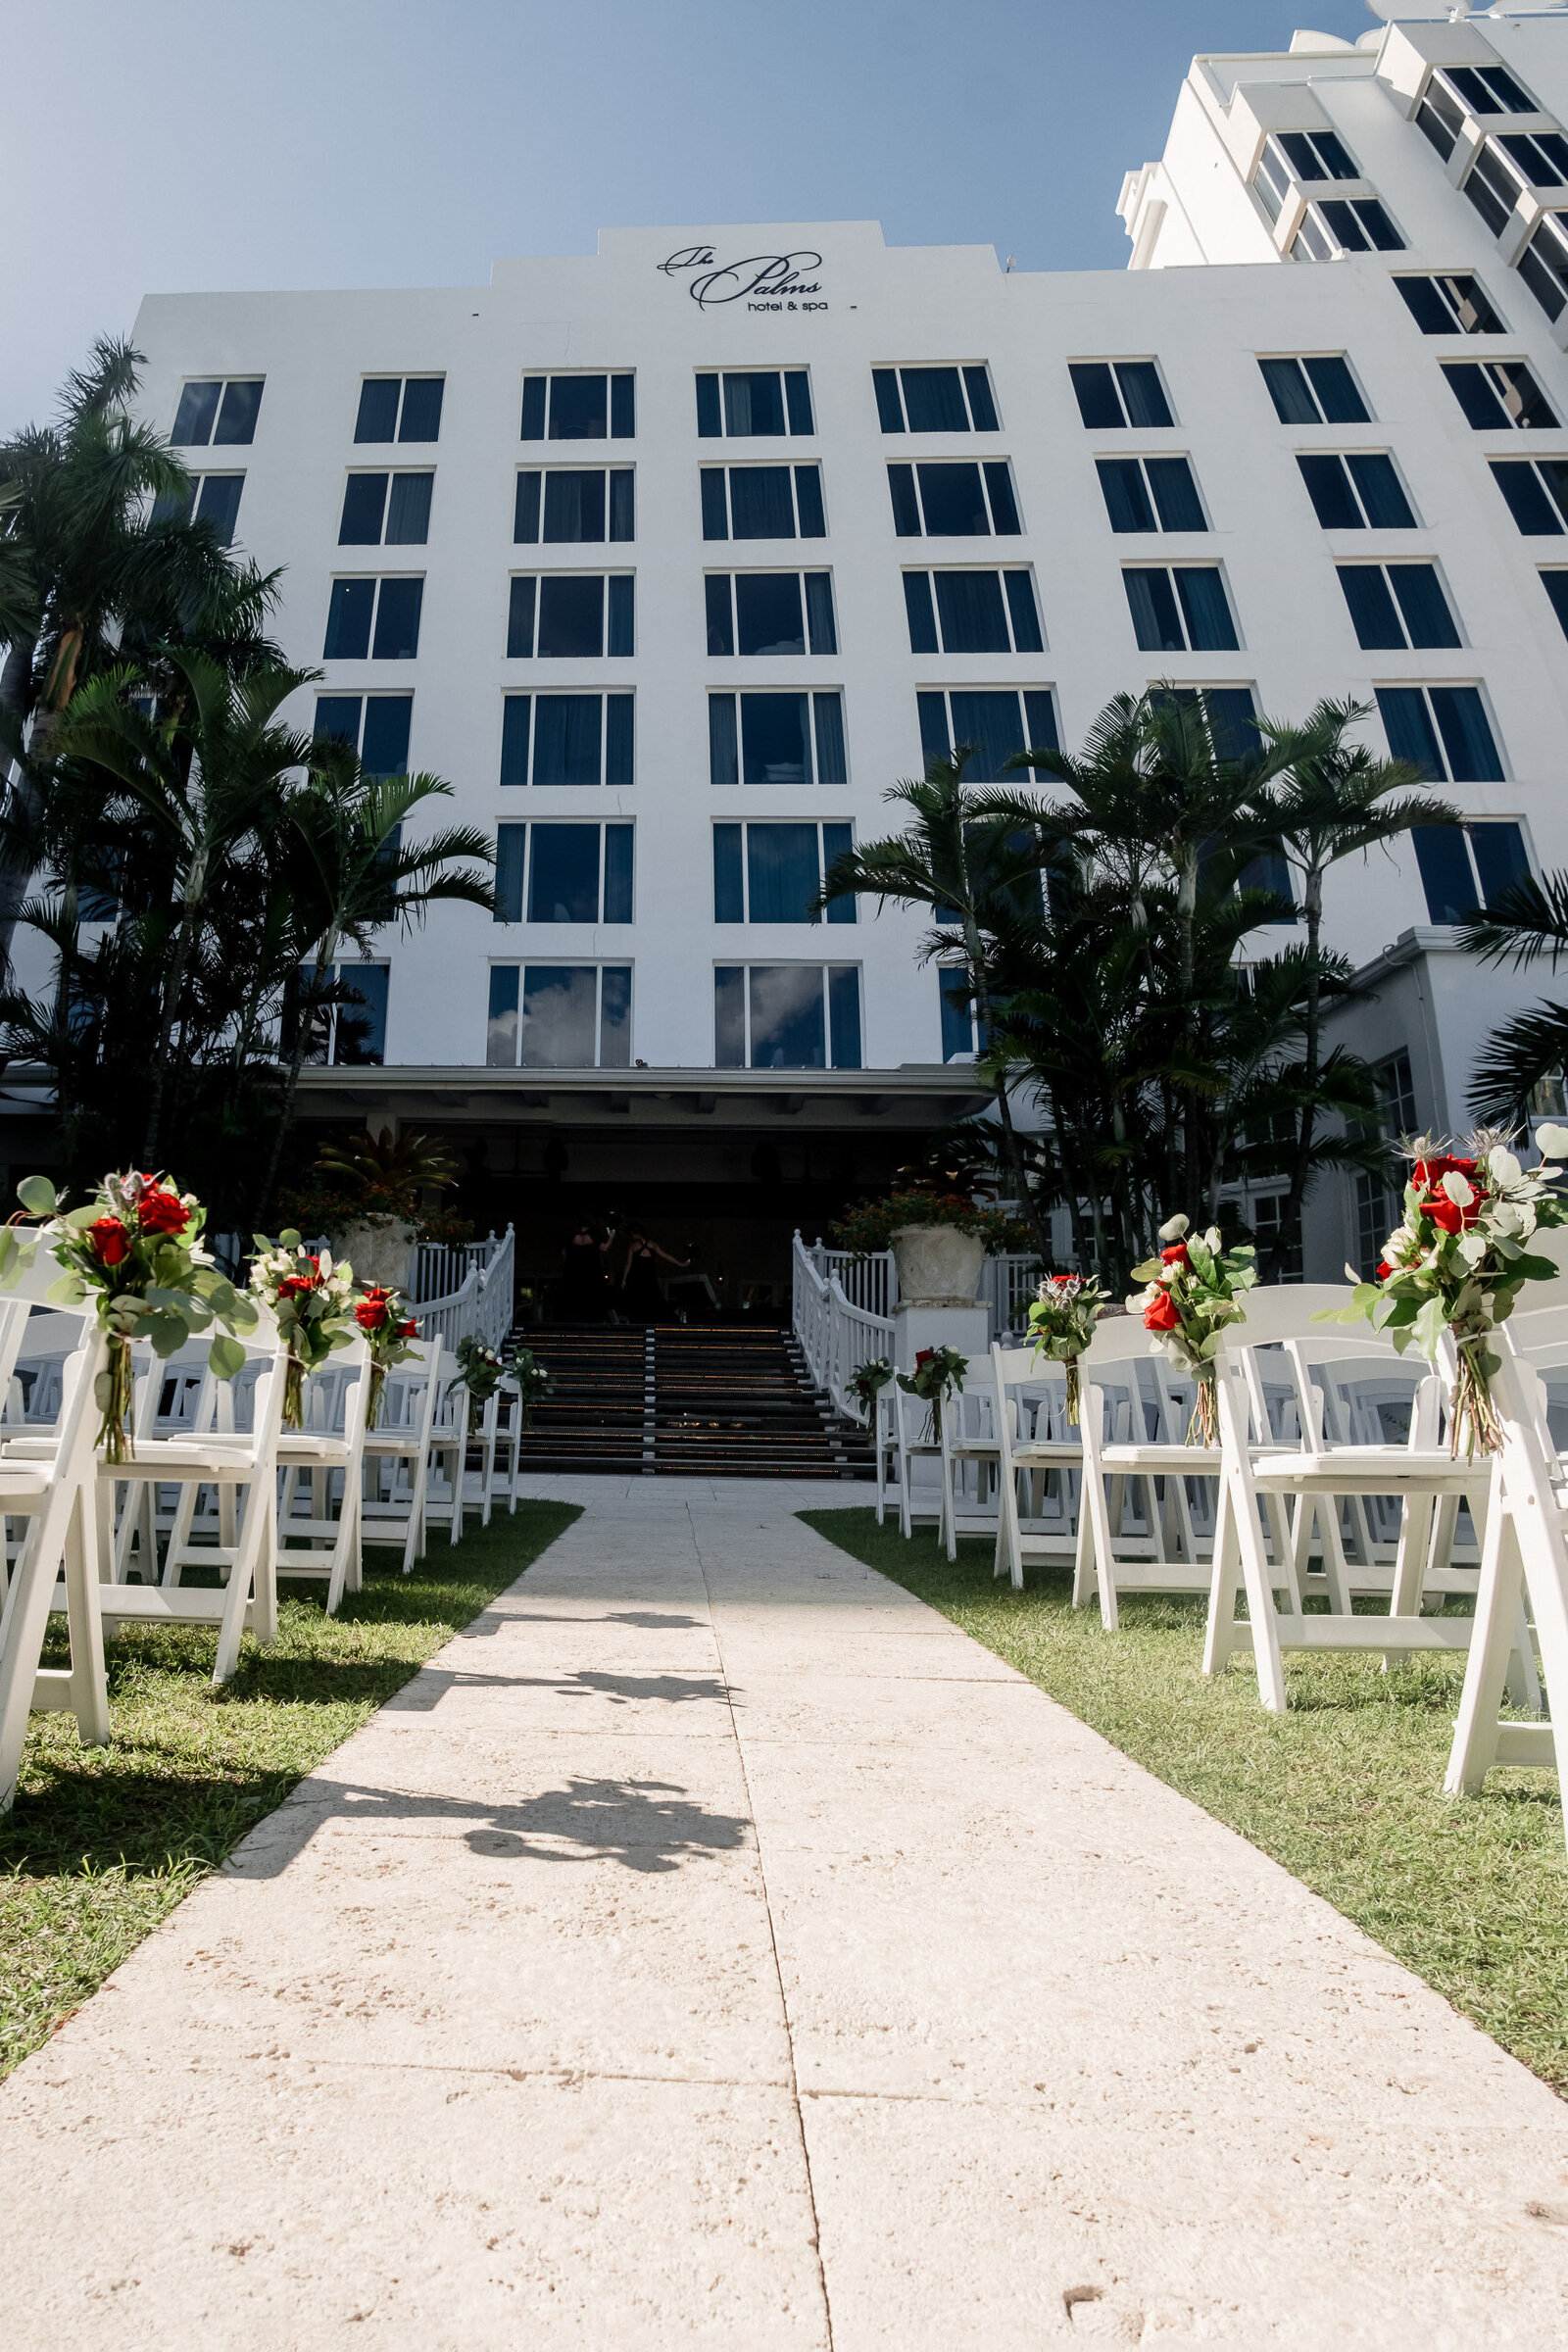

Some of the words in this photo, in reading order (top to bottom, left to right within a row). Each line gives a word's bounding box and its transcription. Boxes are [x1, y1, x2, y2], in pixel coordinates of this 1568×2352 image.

[657, 246, 716, 276] The
[690, 251, 822, 312] Palms
[748, 301, 782, 312] hotel
[787, 301, 799, 312] &
[802, 302, 828, 313] spa
